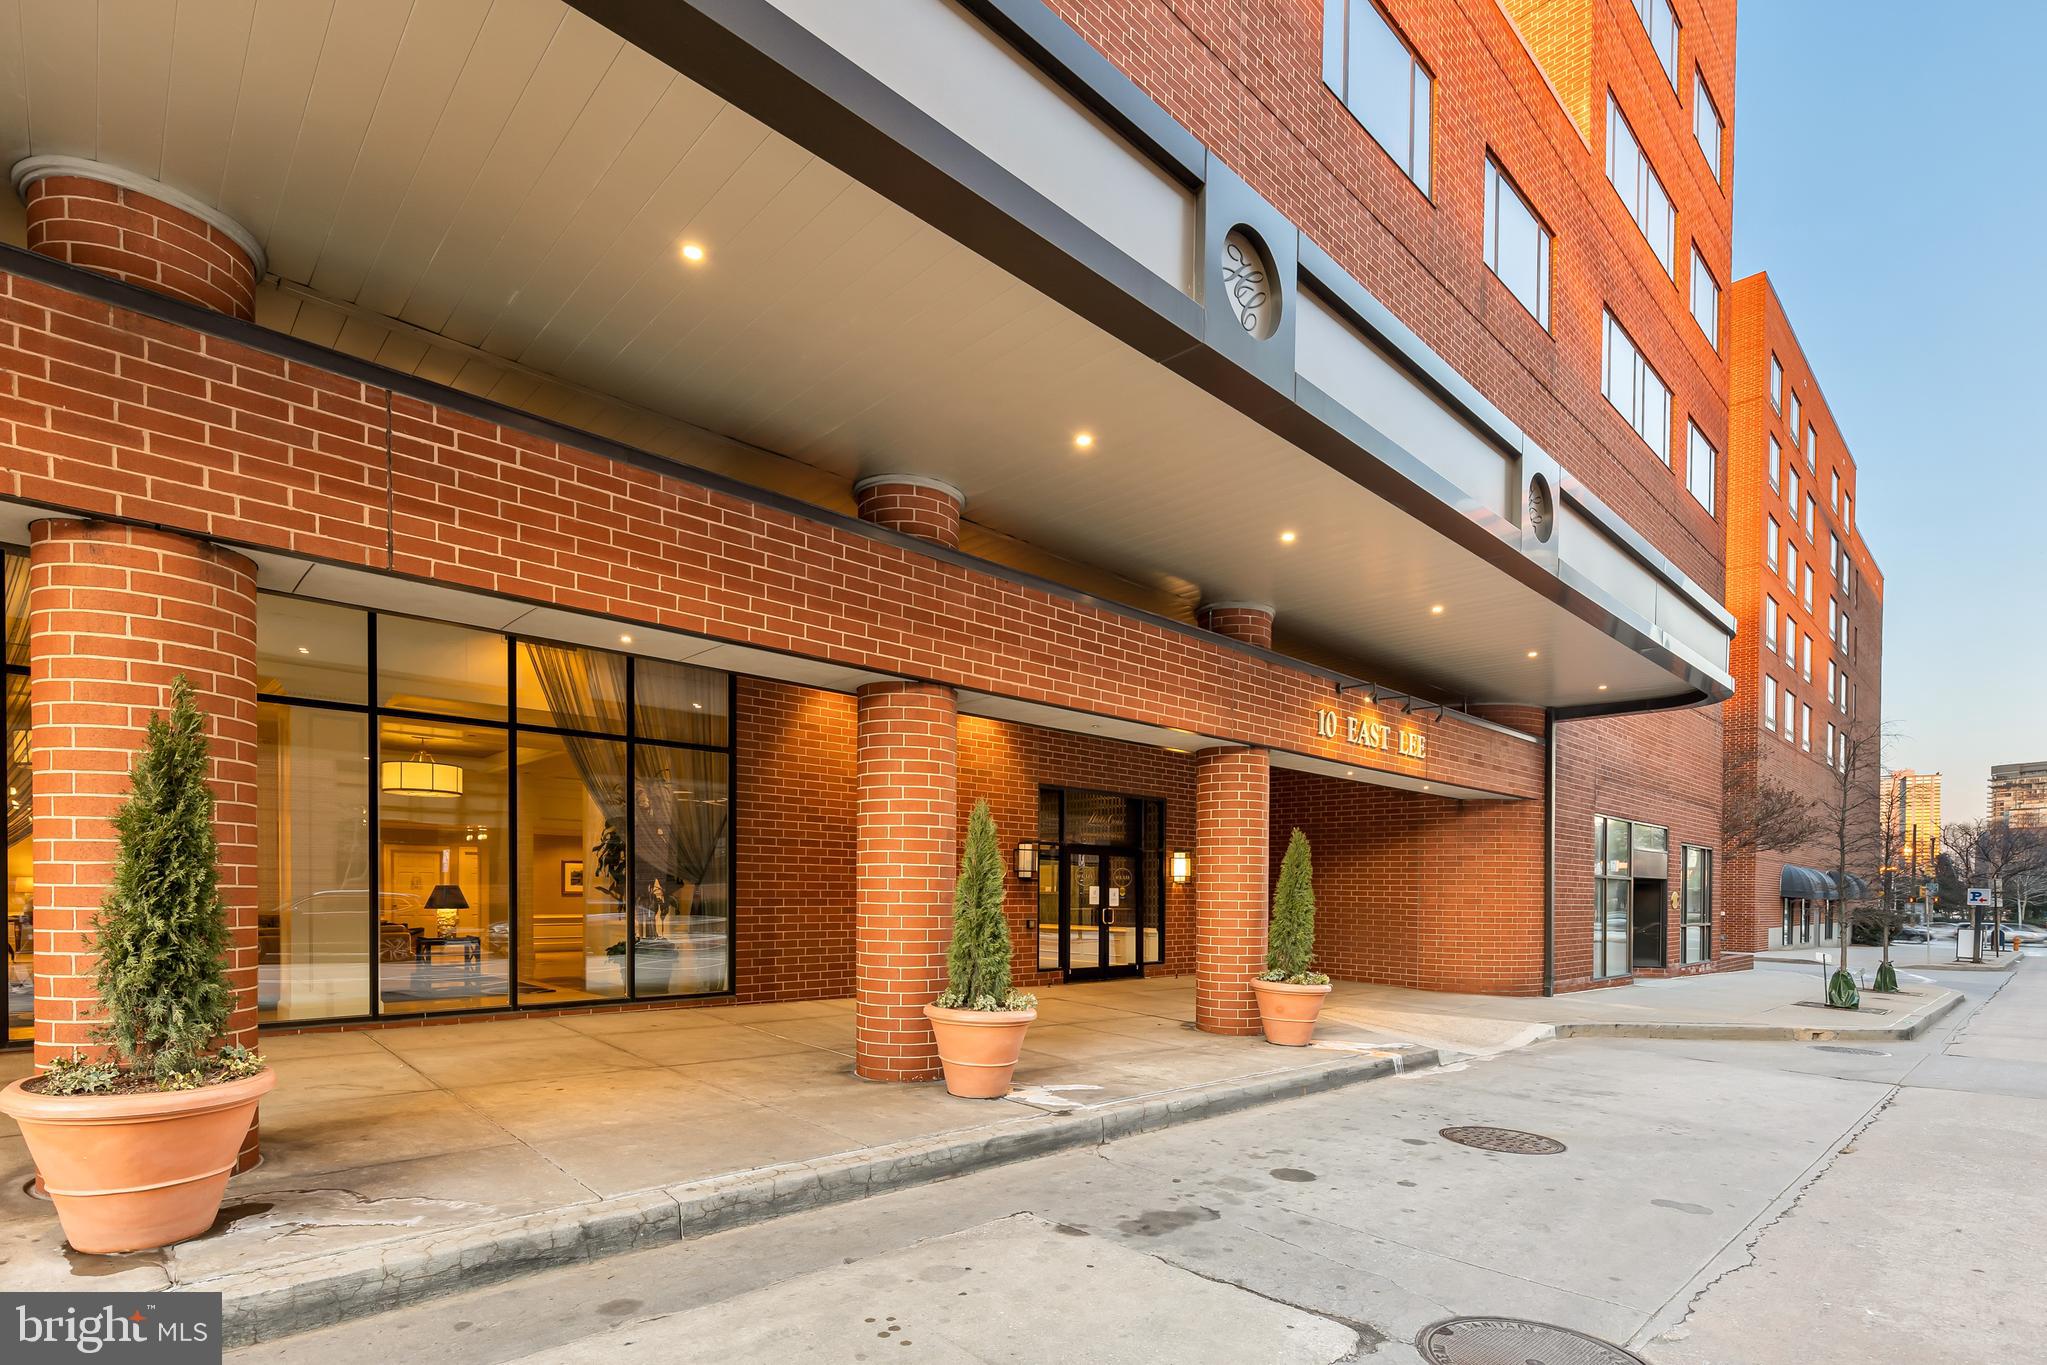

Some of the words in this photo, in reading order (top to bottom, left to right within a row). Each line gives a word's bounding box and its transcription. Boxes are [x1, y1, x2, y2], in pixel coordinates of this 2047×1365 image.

[1317, 708, 1338, 738] 10
[1346, 716, 1391, 751] EAST
[1398, 730, 1427, 759] LEE
[1970, 891, 1983, 902] P
